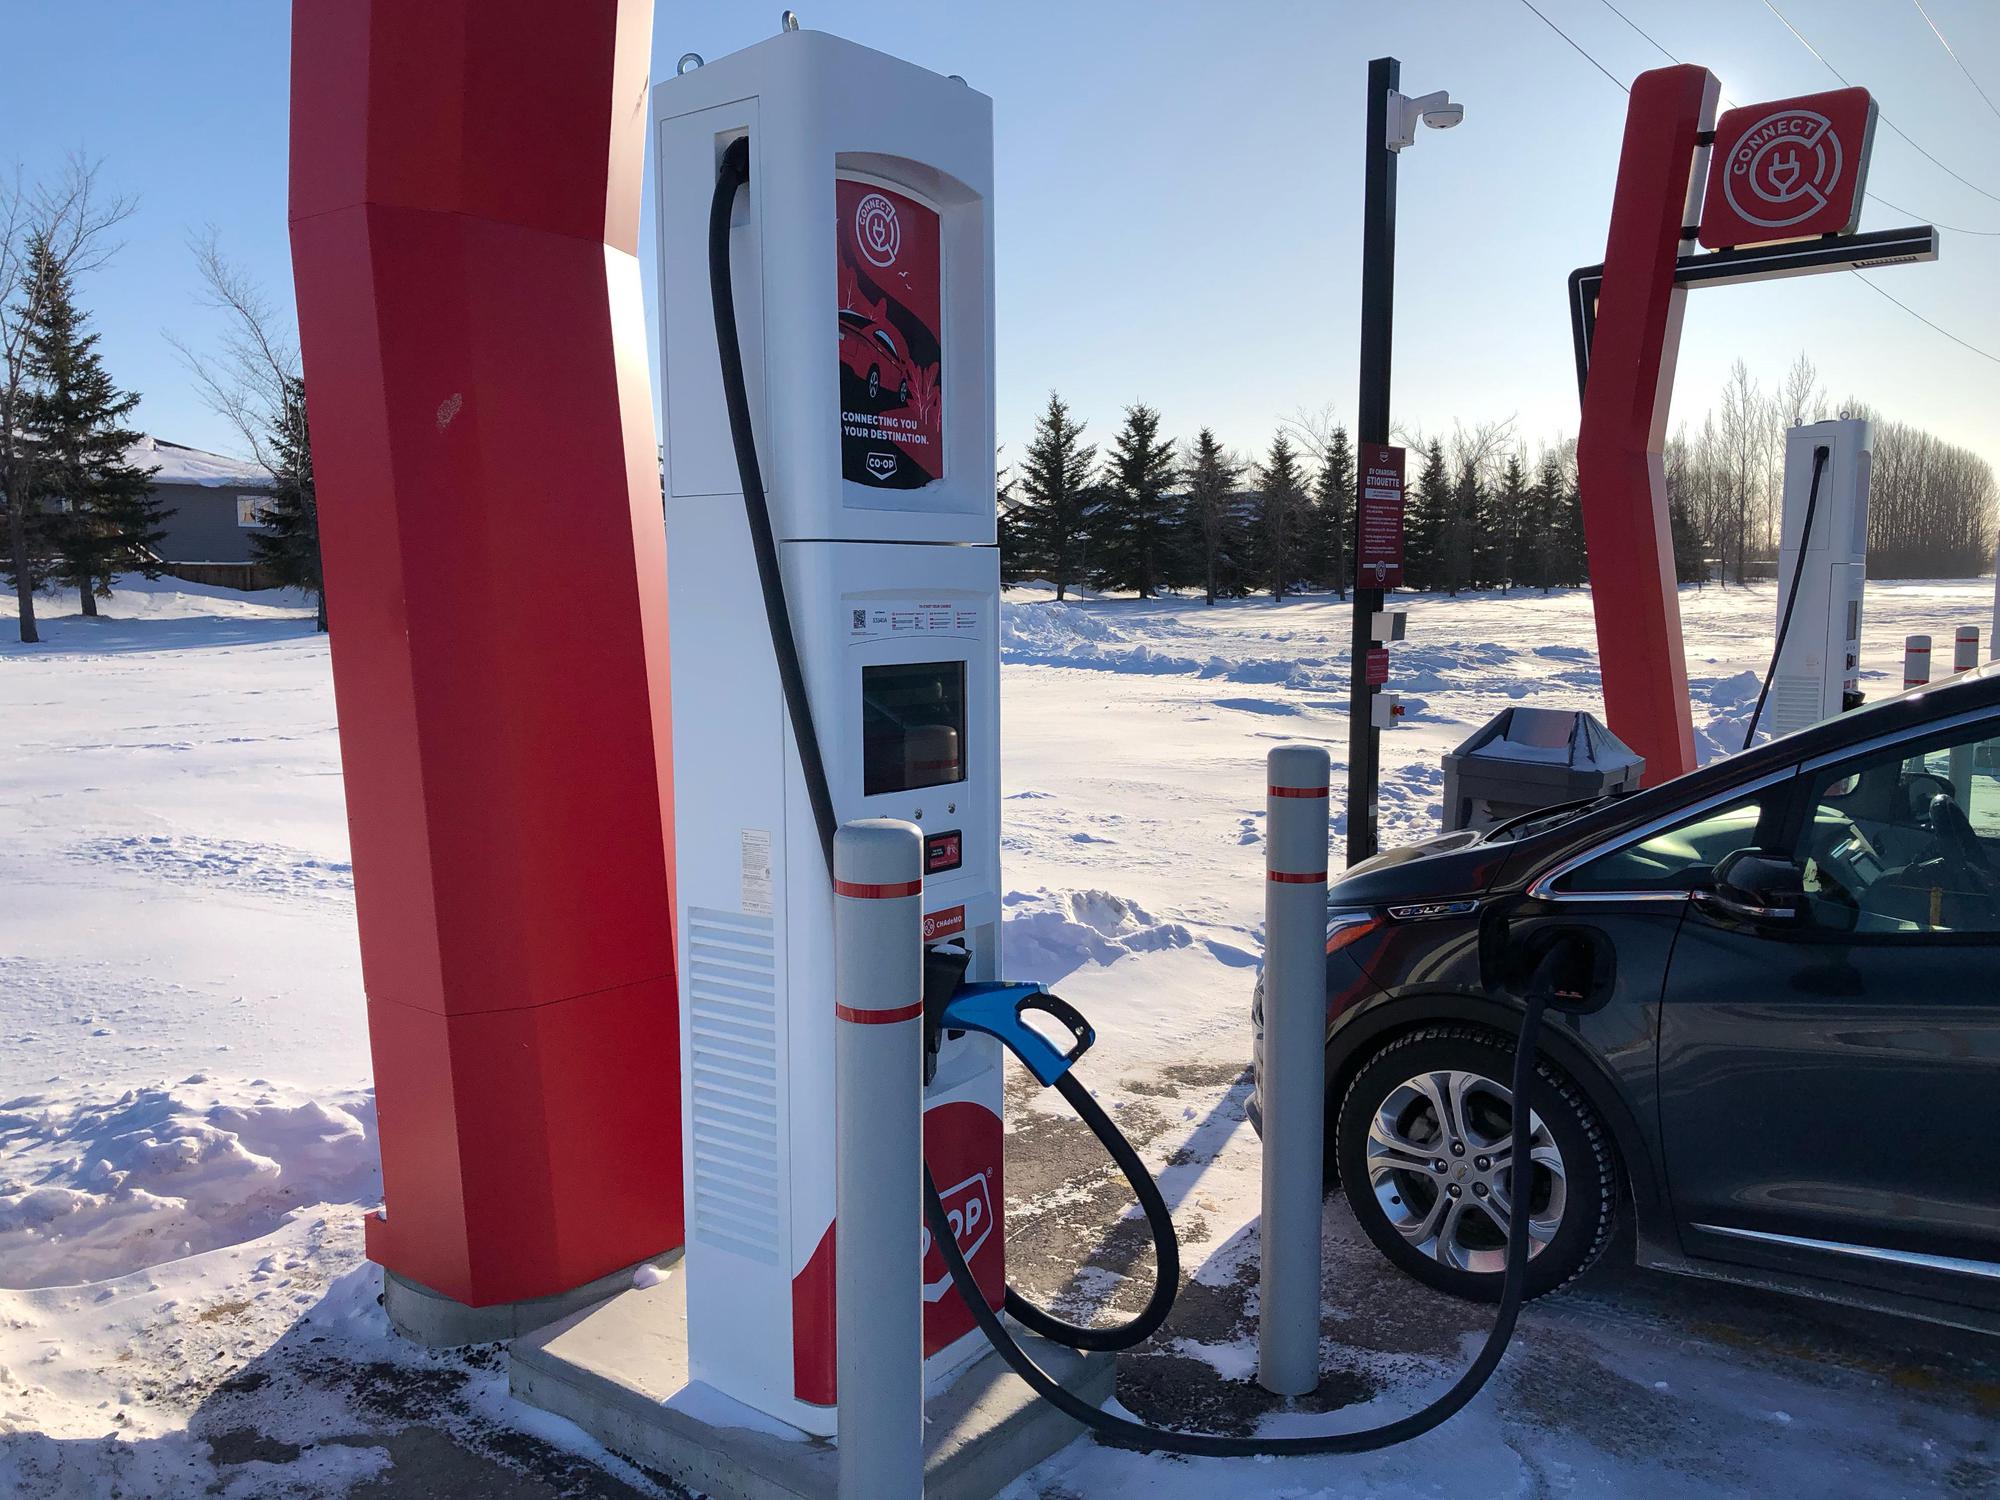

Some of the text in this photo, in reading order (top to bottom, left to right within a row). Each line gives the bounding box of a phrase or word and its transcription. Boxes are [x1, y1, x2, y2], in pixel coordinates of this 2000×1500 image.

[1734, 119, 1816, 175] CONNECT
[860, 199, 890, 225] CONNECT
[842, 411, 917, 430] CONNECTING YOU
[844, 425, 929, 445] YOUR DESTINATION.
[1366, 475, 1400, 488] ETIQUETTE
[936, 915, 962, 928] CHAdeMO
